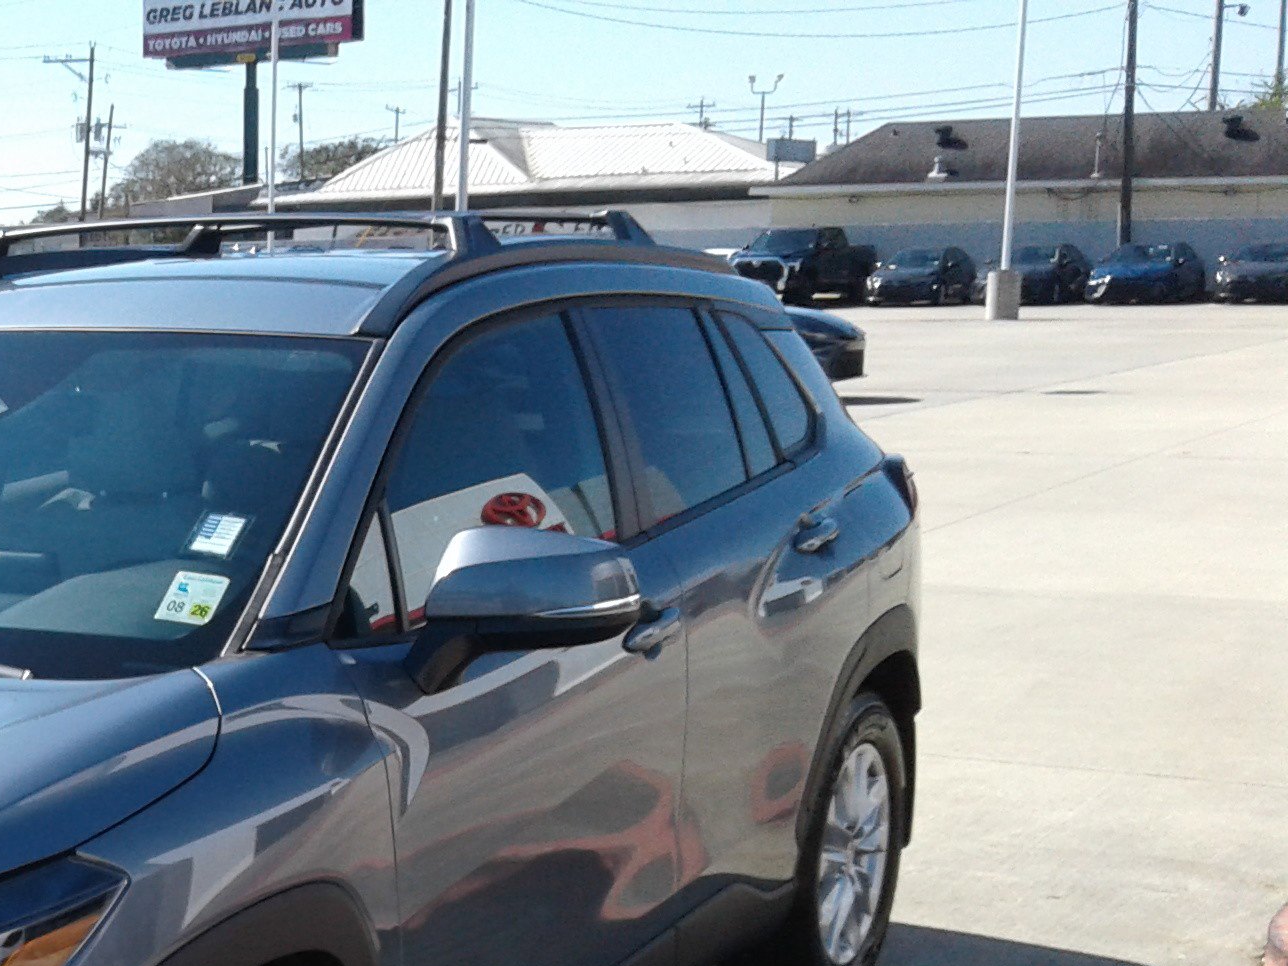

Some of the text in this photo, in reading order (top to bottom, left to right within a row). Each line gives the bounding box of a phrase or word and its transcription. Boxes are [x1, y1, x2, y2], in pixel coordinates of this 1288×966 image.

[145, 4, 195, 25] GREG
[148, 21, 343, 51] TOYOTA HYUNDAI SED CARS
[166, 600, 210, 618] 08 26
